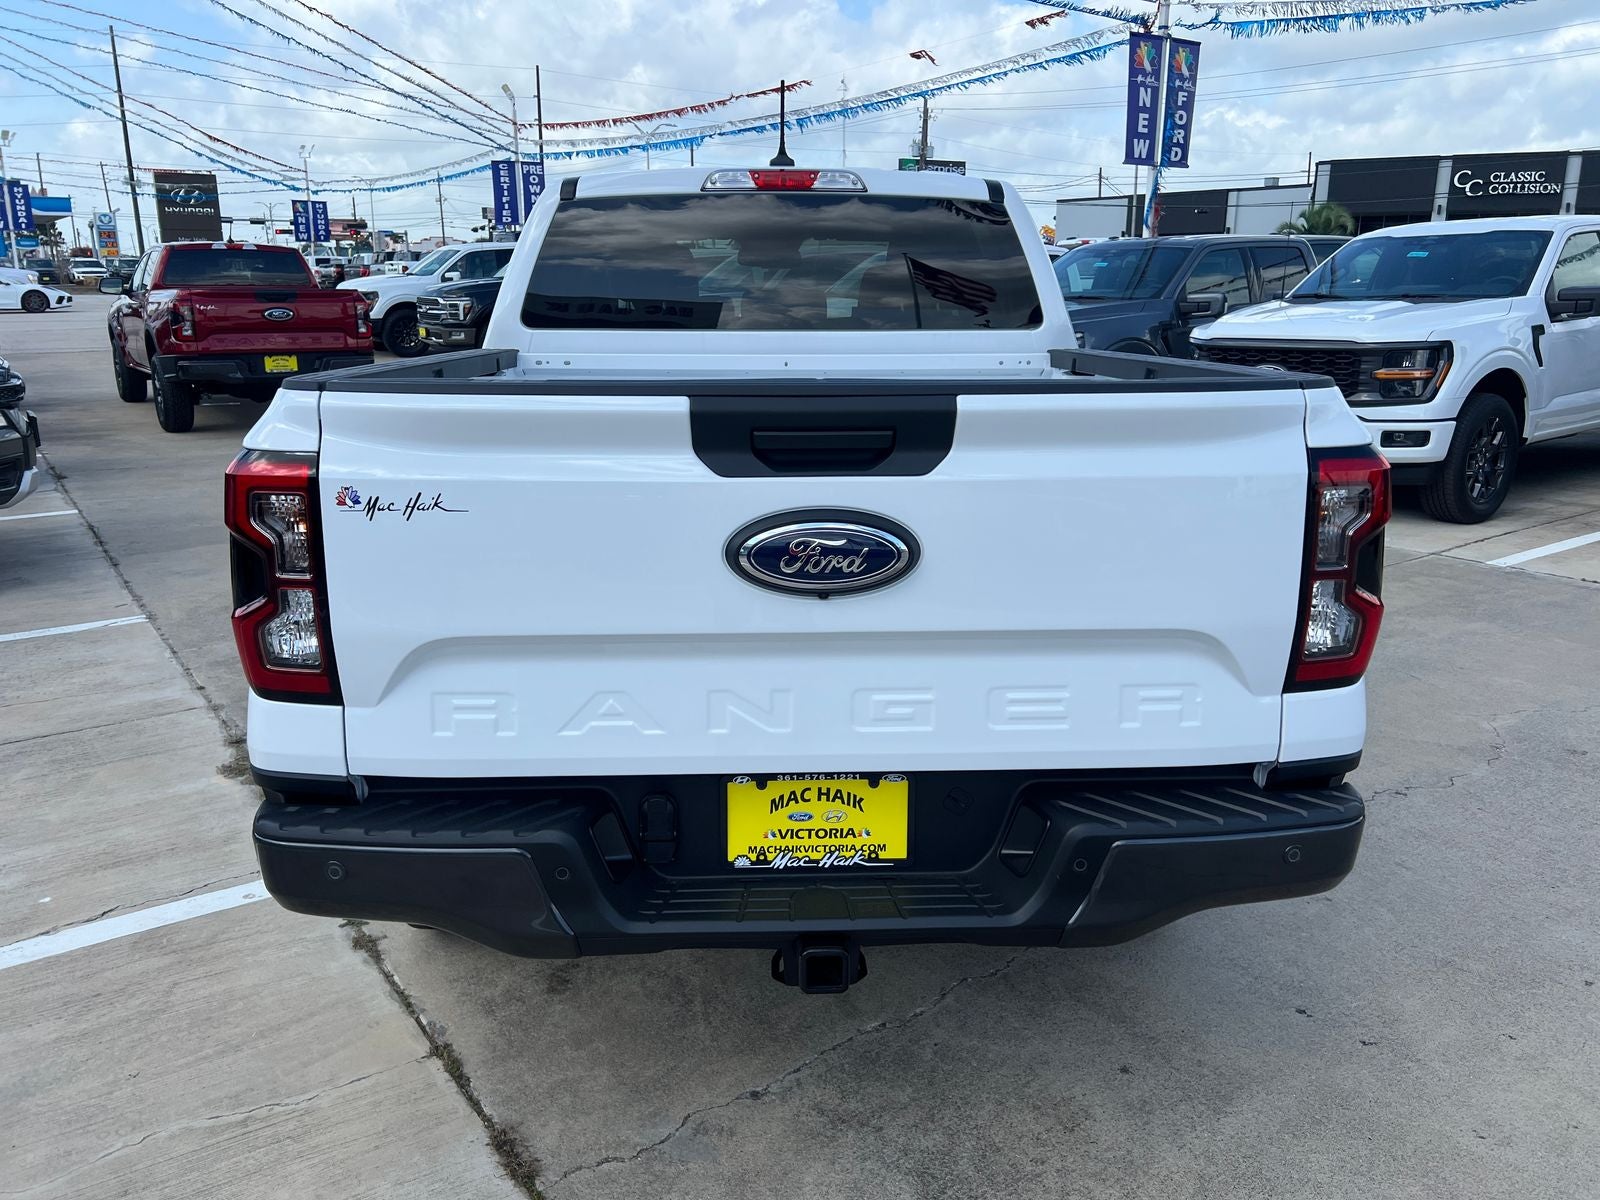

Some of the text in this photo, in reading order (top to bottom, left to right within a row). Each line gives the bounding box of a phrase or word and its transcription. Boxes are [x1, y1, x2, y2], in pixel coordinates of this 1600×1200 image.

[1133, 87, 1151, 159] NEW
[1170, 92, 1188, 162] FORD
[522, 164, 543, 174] PRE
[1490, 171, 1546, 182] CLASSIC
[499, 163, 512, 223] CERTIFIED
[529, 175, 540, 208] OWN
[1488, 183, 1561, 194] COLLISION
[13, 187, 28, 229] HYUNDAI
[164, 206, 215, 215] HYUNDAI
[316, 203, 326, 240] HYUNDAI
[298, 216, 308, 240] NEW
[363, 492, 450, 521] Mac Haik
[780, 537, 868, 573] Ford
[431, 684, 1202, 736] RANGER
[770, 787, 865, 815] MAC HAIK
[777, 828, 857, 840] VICTORIA
[748, 843, 887, 854] MACHAIKVICTORIACOM
[770, 850, 872, 869] Mac Haik
